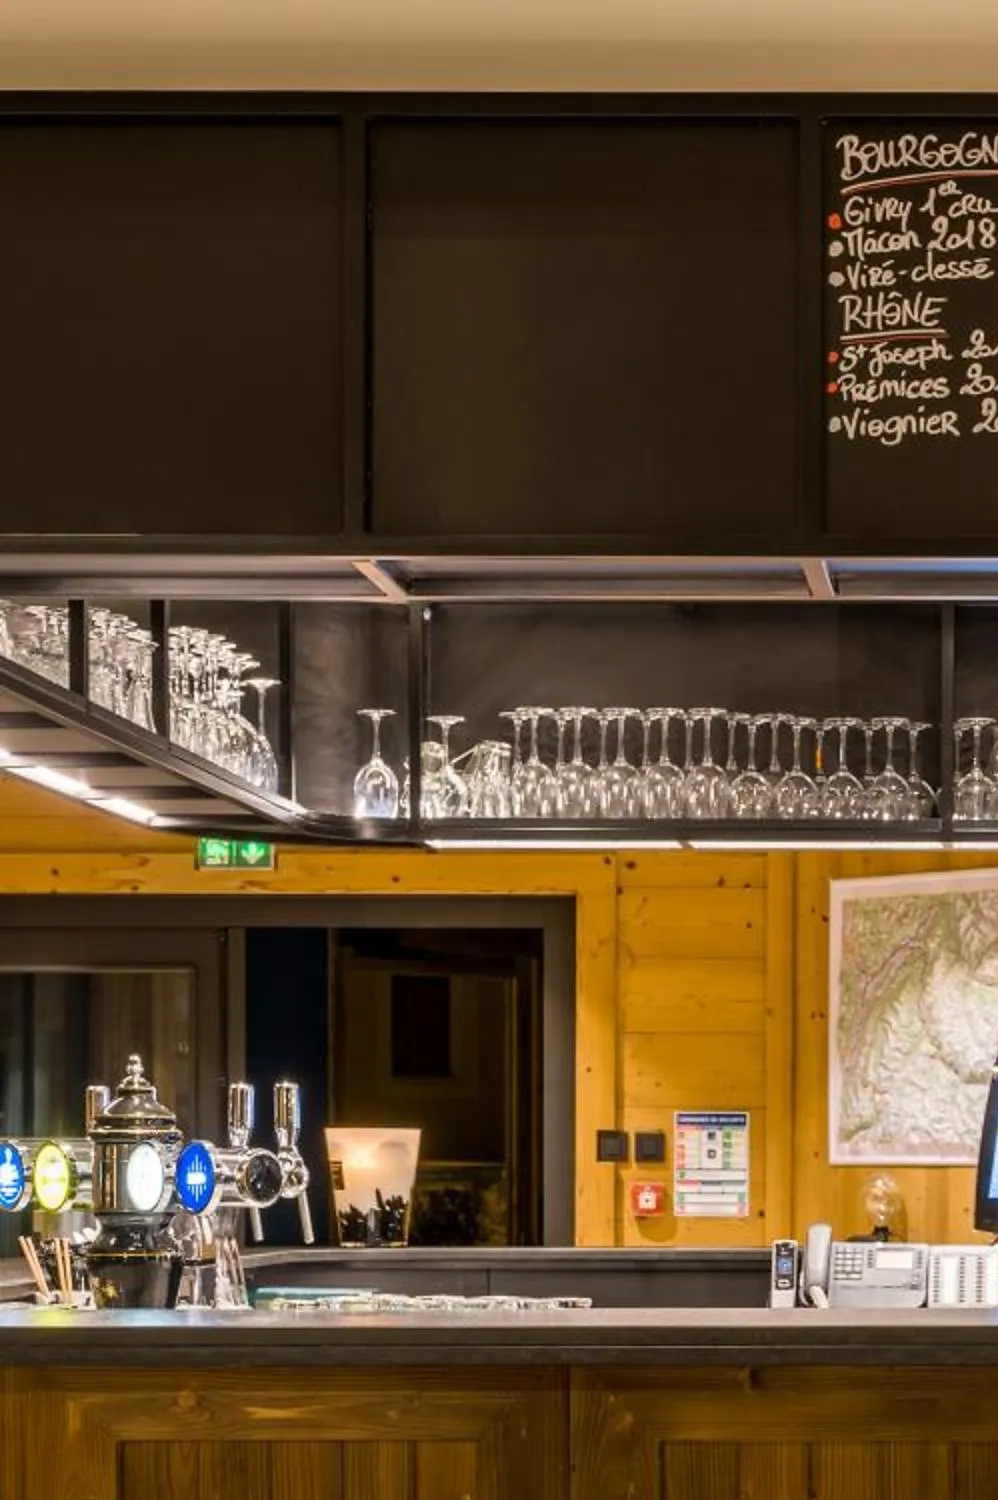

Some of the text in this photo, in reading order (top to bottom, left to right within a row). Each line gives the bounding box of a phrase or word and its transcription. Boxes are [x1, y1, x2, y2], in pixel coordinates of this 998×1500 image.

[928, 215, 997, 251] 2018
[837, 291, 948, 332] RHÔNE
[868, 338, 953, 377] Joseph
